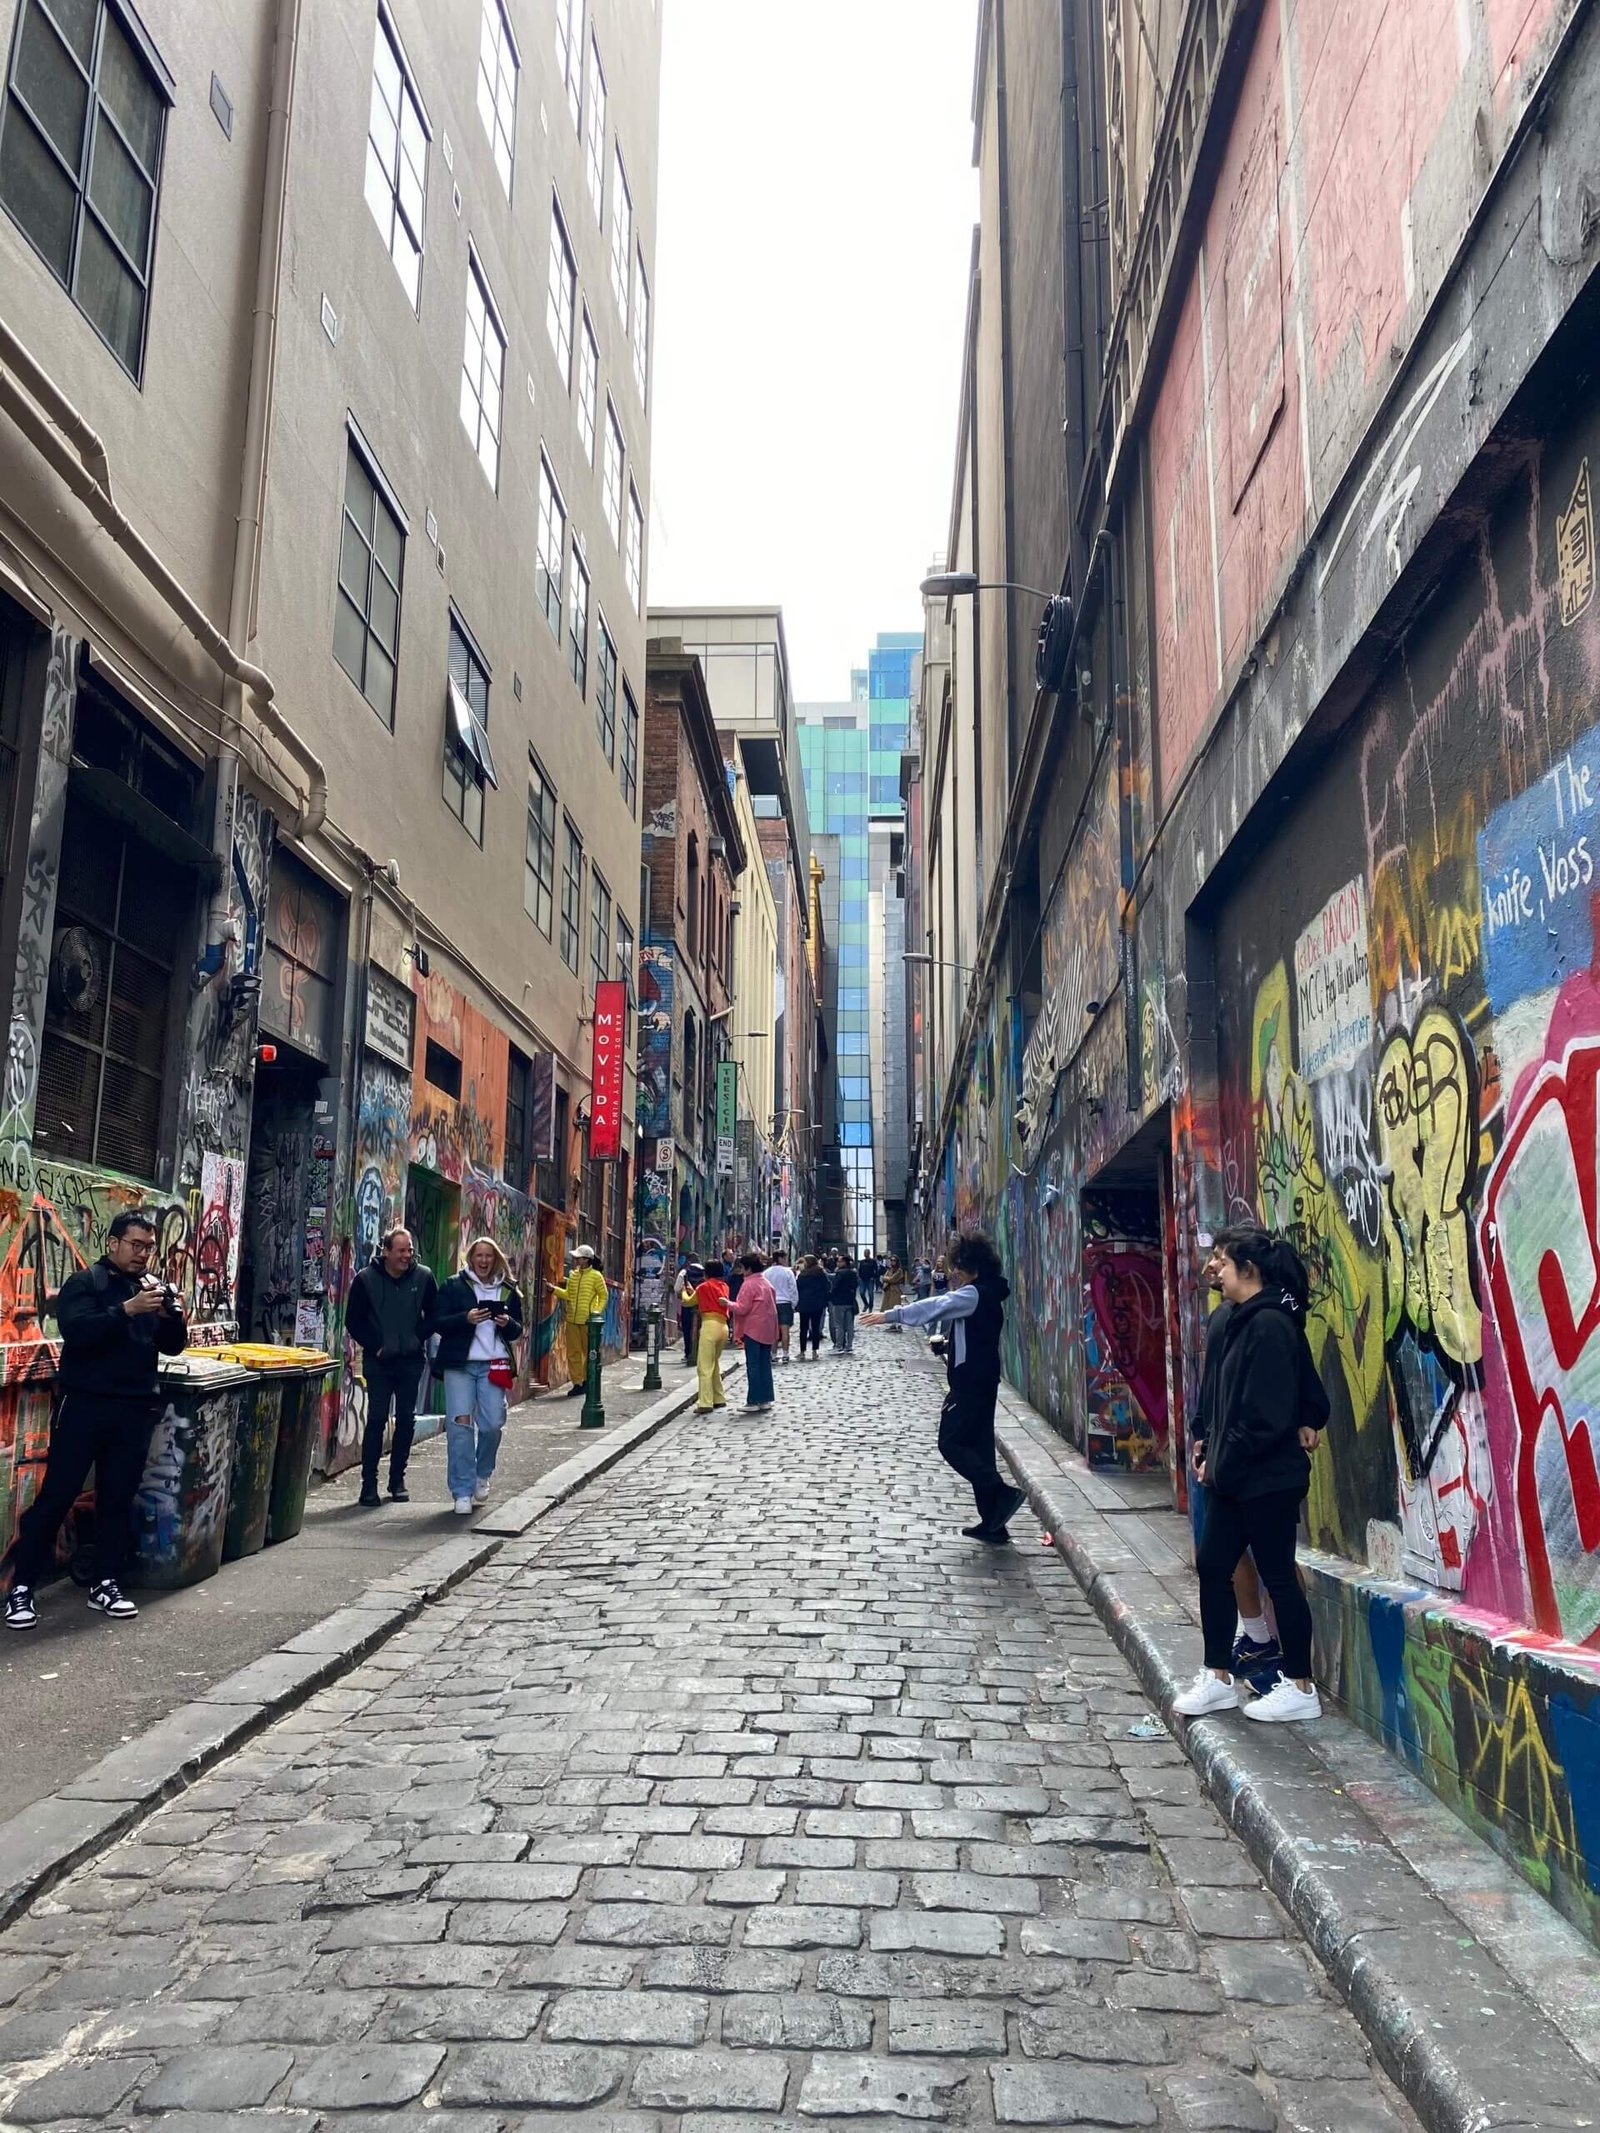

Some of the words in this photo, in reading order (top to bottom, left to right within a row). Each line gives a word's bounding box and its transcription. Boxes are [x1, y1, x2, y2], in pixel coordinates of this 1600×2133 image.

[1543, 753, 1594, 829] The
[1537, 835, 1595, 903] Voss
[1323, 885, 1361, 956] RAYGUN
[595, 1013, 612, 1126] MOVIDA
[613, 1054, 621, 1085] TAPAS
[722, 1068, 731, 1101] TRES
[611, 1101, 619, 1126] VINO
[719, 1139, 732, 1148] END
